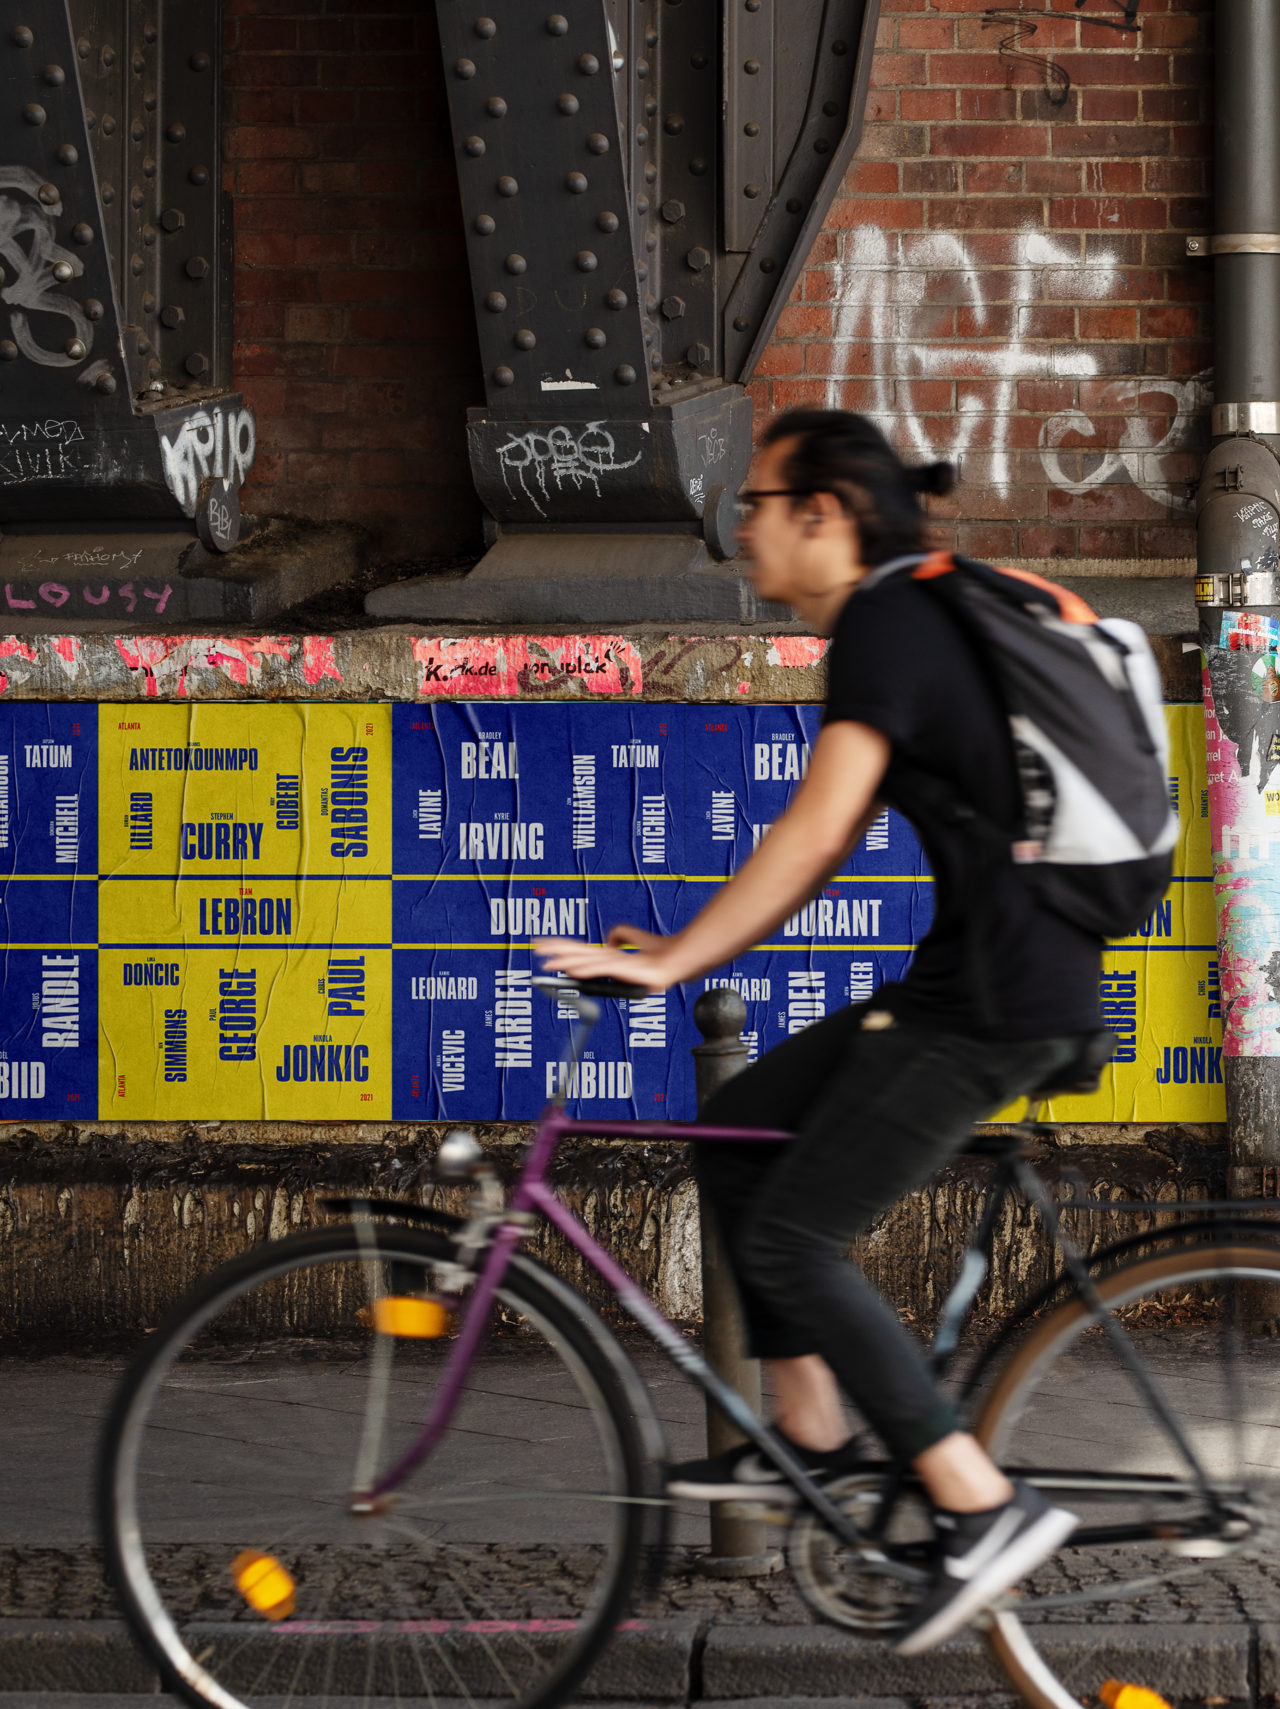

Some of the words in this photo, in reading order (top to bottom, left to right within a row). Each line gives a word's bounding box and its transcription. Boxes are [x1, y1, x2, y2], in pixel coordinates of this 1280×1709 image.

[5, 582, 173, 614] LOUSY
[479, 732, 501, 740] BRADLEY
[772, 733, 795, 741] BRADLEY
[25, 745, 72, 768] TATUM
[130, 747, 258, 770] ANTETOKOUNMPO
[461, 742, 519, 780] BEAL
[611, 745, 659, 768] TATUM
[211, 812, 233, 820] STEPHEN
[276, 773, 298, 829] GOBERT
[331, 746, 368, 857] SABONIS
[419, 789, 441, 839] LAVINE
[573, 755, 595, 850] WILLIAMSON
[712, 791, 734, 840] LAVINE
[56, 794, 78, 863] MITCHELL
[130, 792, 152, 849] LILLARD
[642, 794, 665, 863] MITCHELL
[181, 822, 263, 859] CURRY
[459, 822, 544, 860] IRVING
[200, 898, 291, 935] LEBRON
[490, 898, 589, 936] DURANT
[124, 963, 179, 986] DONCIC
[328, 956, 365, 1016] PAUL
[412, 977, 477, 1000] LEONARD
[1198, 980, 1206, 996] CHRIS
[42, 954, 79, 1047] RANDLE
[219, 968, 256, 1060] GEORGE
[495, 969, 532, 1068] HARDEN
[778, 1011, 786, 1028] JAMES
[165, 1008, 187, 1082] SIMMONS
[313, 1034, 332, 1042] NIKOLA
[1193, 1036, 1213, 1044] NIKOLA
[0, 1061, 45, 1099] BIID
[276, 1044, 369, 1082] JONKIC
[442, 1030, 465, 1092] VUCEVIC
[1156, 1046, 1223, 1084] JONK
